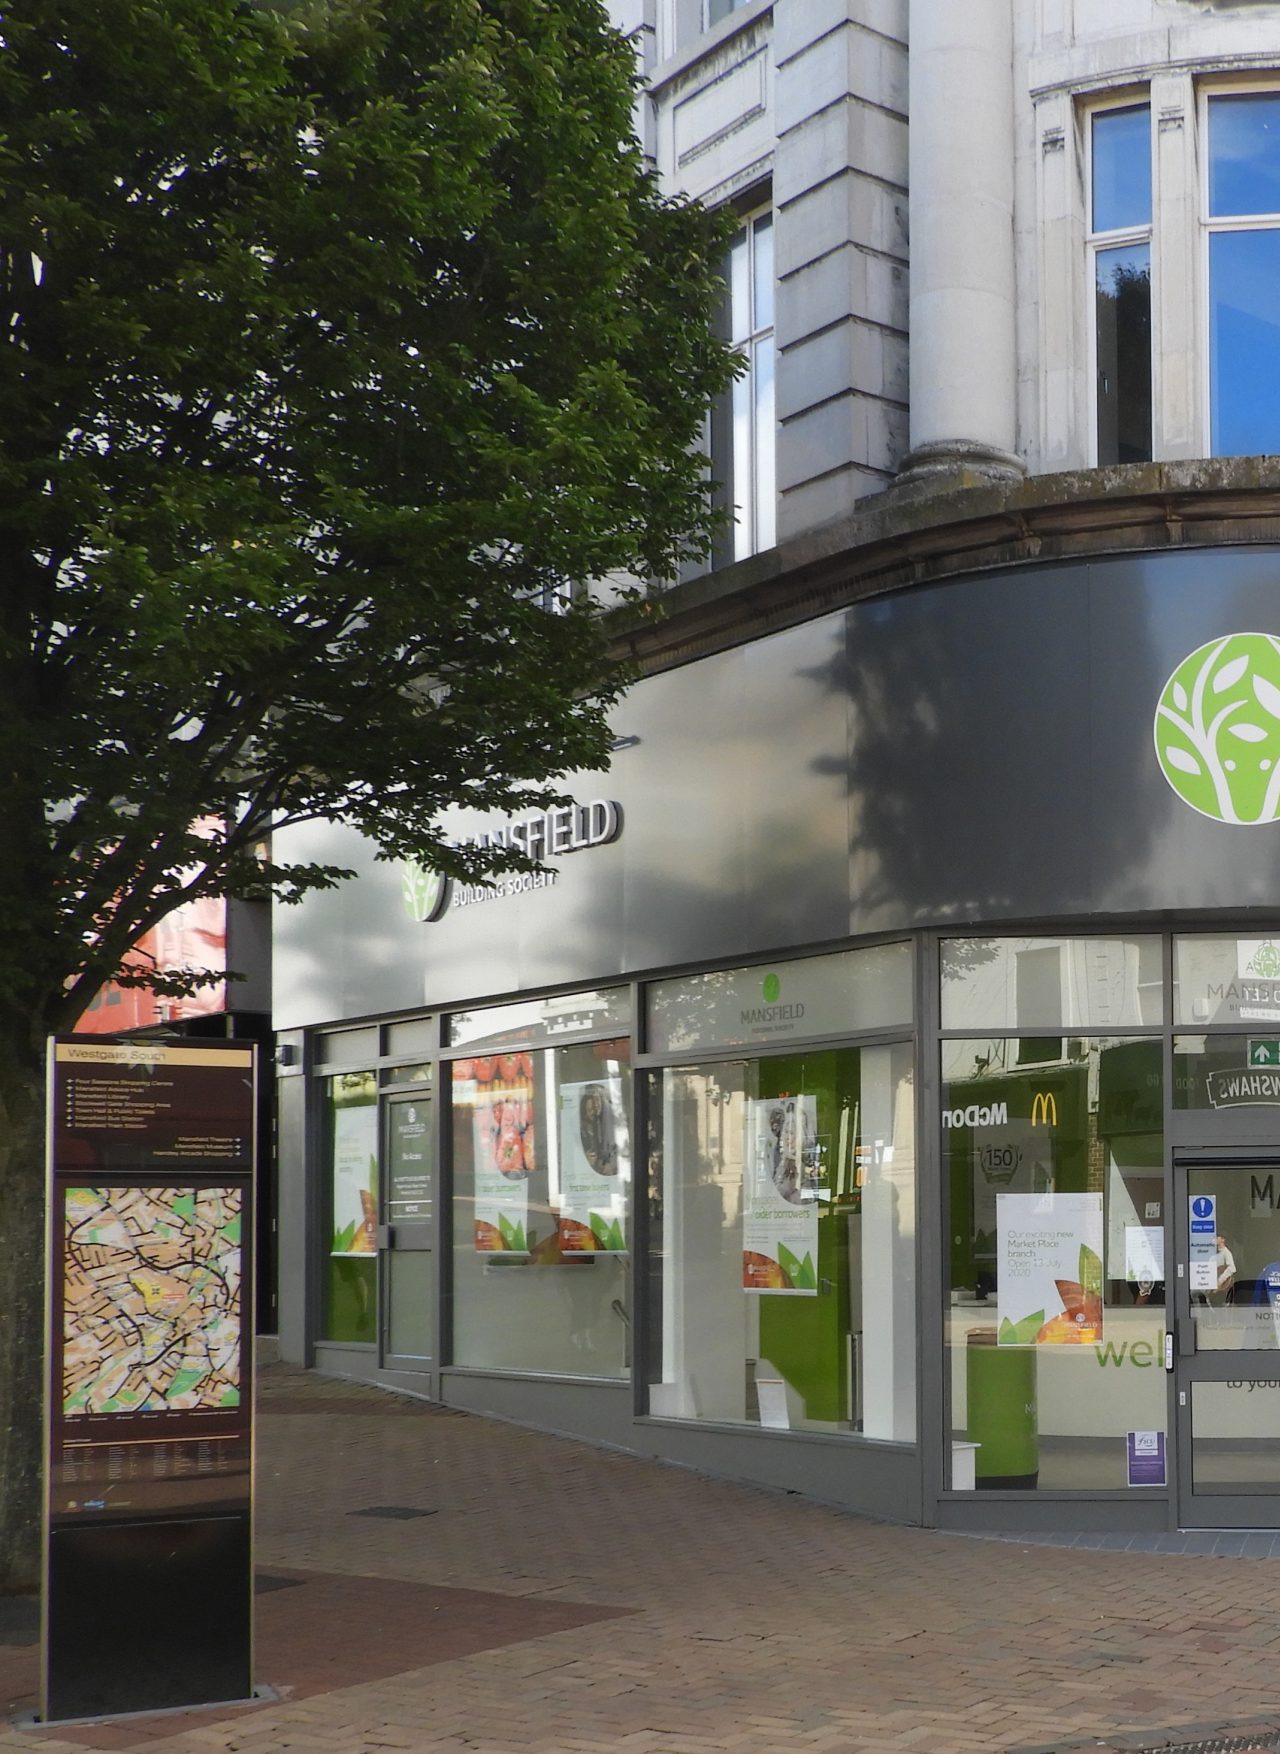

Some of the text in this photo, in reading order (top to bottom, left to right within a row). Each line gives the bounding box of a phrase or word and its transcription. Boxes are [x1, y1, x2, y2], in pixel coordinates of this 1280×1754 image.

[453, 871, 557, 907] BUILDING SOCIETY
[740, 1003, 805, 1025] MANSFIELD
[68, 1048, 127, 1060] Westgate
[986, 1149, 1013, 1167] 150
[1007, 1230, 1024, 1239] Our
[1057, 1231, 1074, 1239] new
[1007, 1239, 1060, 1248] Market Place
[1007, 1249, 1036, 1258] branch
[1007, 1259, 1032, 1270] Open
